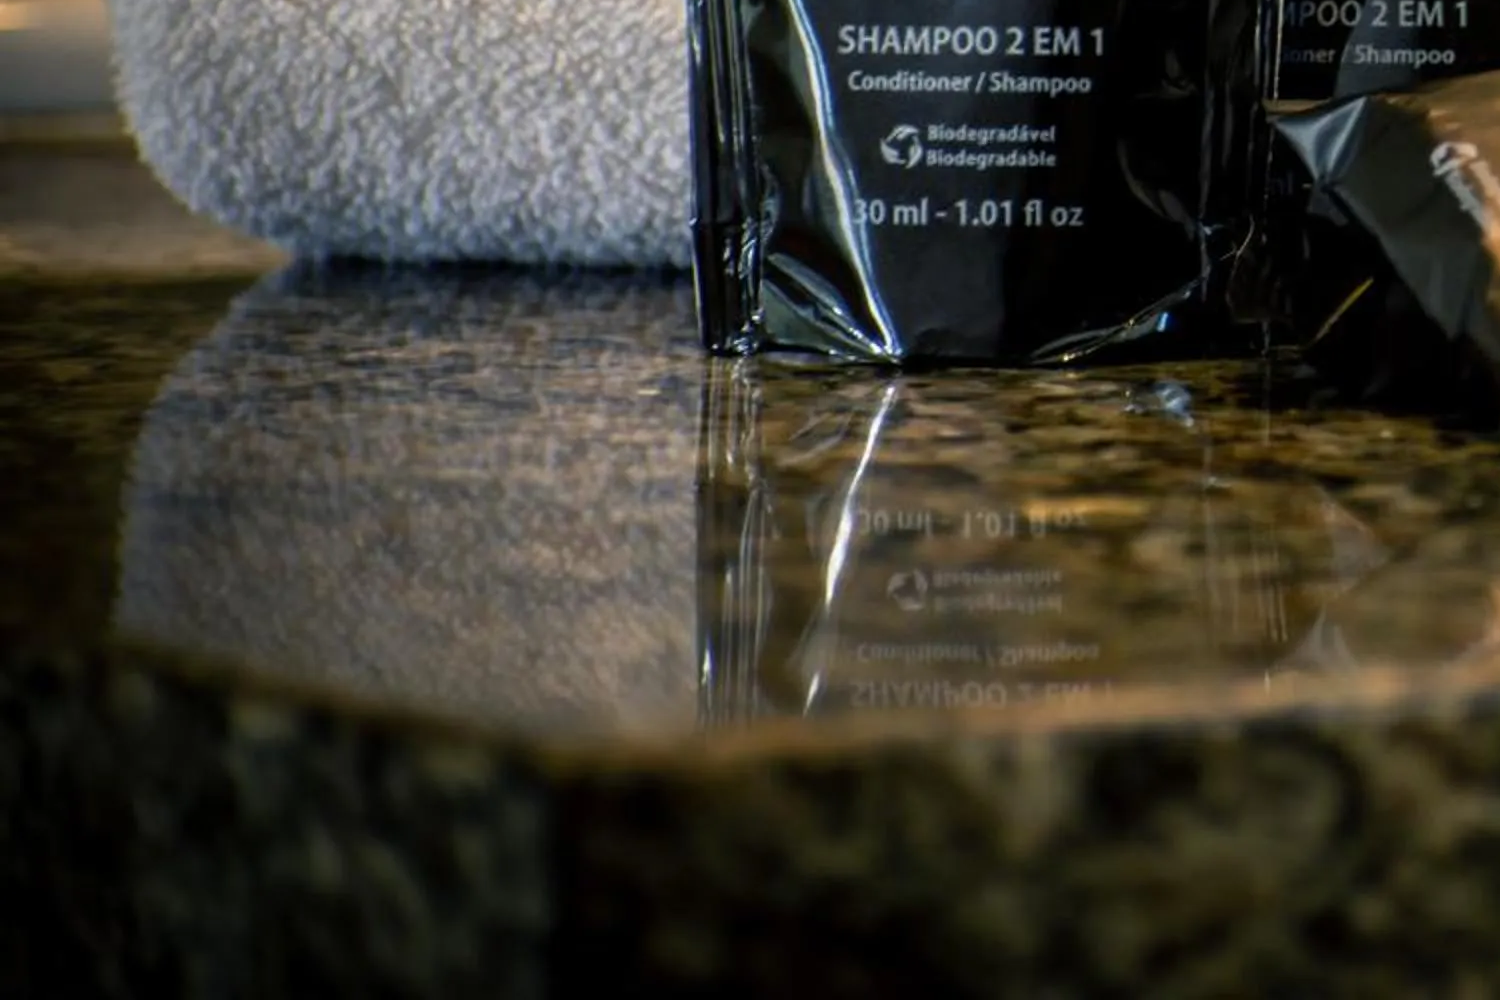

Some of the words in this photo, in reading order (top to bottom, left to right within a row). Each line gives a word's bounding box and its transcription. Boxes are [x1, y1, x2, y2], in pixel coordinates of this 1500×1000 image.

[1371, 1, 1389, 27] 2
[1398, 0, 1444, 28] EM
[1455, 1, 1468, 27] 1
[838, 25, 998, 56] SHAMPOO
[1005, 26, 1024, 56] 2
[1033, 27, 1081, 57] EM
[1090, 28, 1104, 56] 1
[1353, 43, 1456, 69] Shampoo
[848, 69, 971, 93] Conditioner
[975, 71, 986, 93] /
[988, 72, 1092, 98] Shampoo
[926, 149, 1057, 171] Biodegradable
[852, 199, 886, 226] 30
[893, 198, 928, 226] ml
[954, 200, 1013, 227] 1.01
[1024, 200, 1043, 227] fl
[1050, 206, 1084, 227] oz
